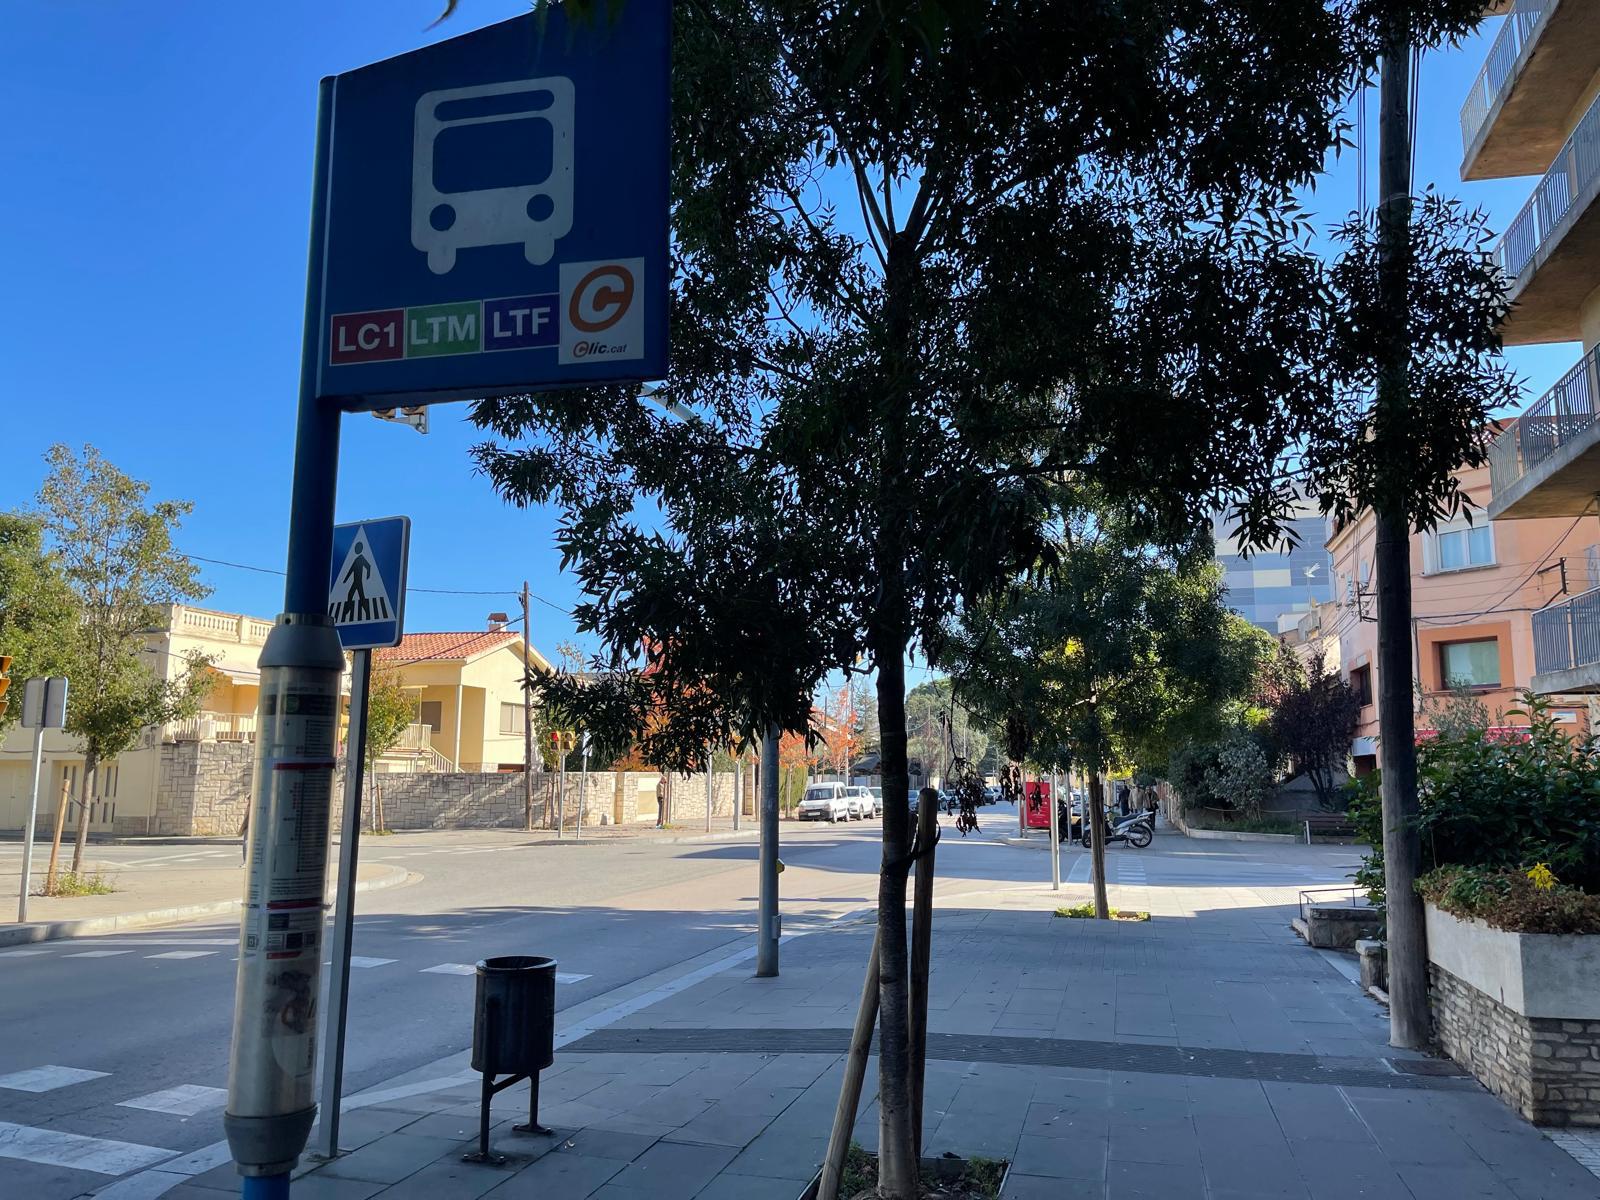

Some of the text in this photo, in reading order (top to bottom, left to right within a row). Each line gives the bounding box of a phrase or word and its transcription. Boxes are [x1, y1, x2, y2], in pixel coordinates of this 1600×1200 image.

[338, 306, 551, 352] LC1 LTM LTF
